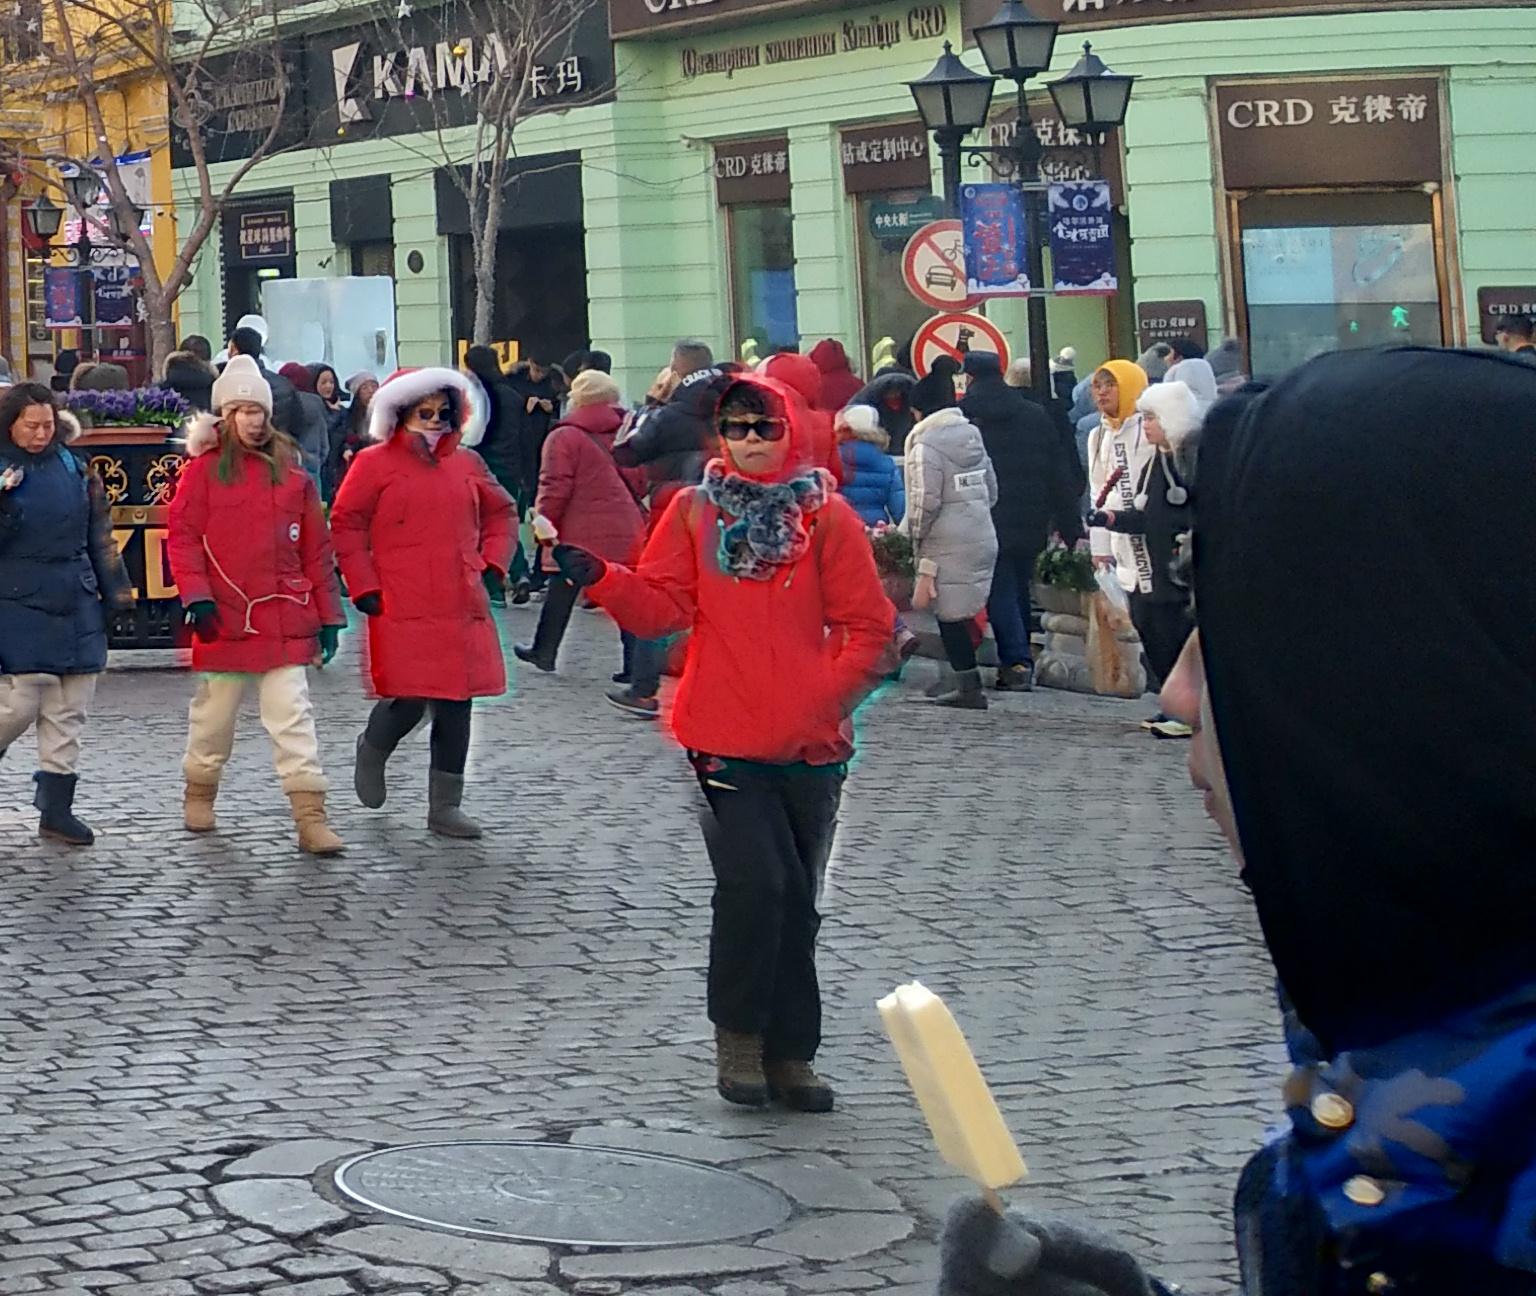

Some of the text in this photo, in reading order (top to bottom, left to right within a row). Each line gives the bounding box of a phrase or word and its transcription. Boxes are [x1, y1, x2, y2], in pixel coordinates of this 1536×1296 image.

[906, 3, 947, 40] CRD
[528, 56, 583, 99] 卡玛
[1228, 98, 1314, 128] CRD
[715, 155, 747, 178] CRD
[1488, 304, 1518, 315] CRD
[1141, 318, 1167, 329] CRD
